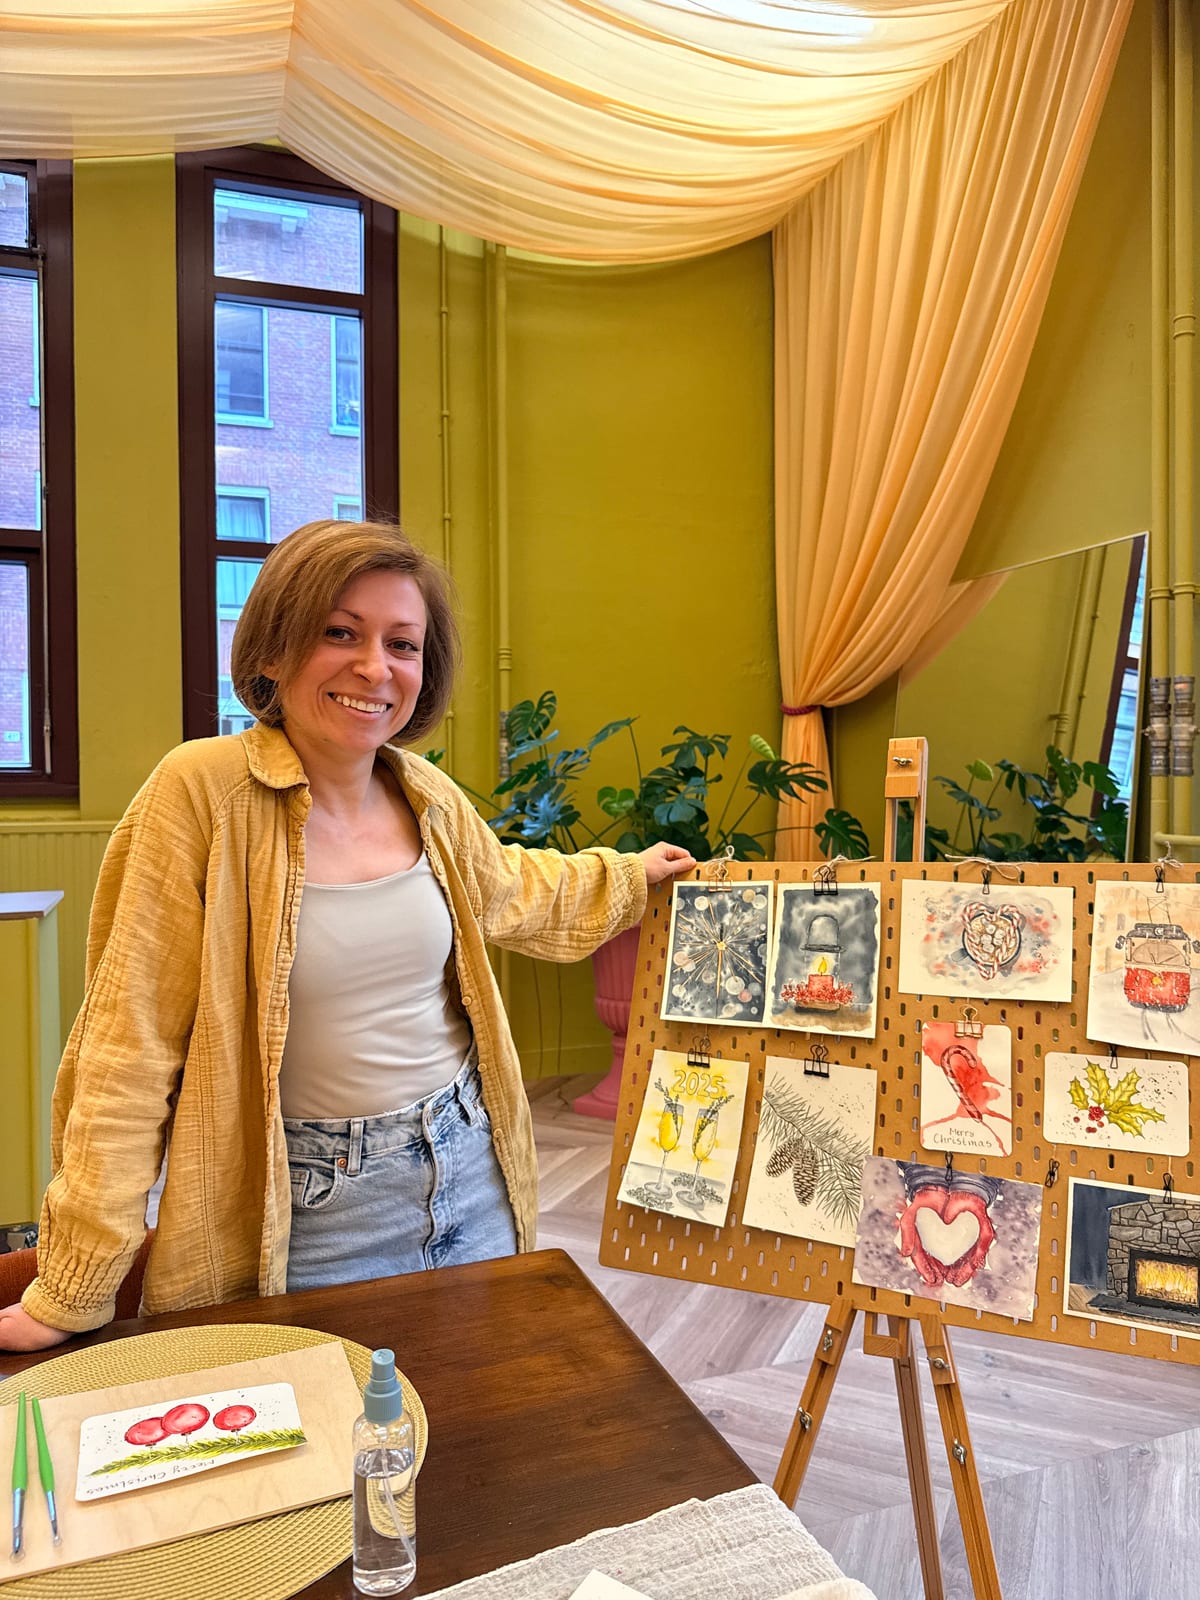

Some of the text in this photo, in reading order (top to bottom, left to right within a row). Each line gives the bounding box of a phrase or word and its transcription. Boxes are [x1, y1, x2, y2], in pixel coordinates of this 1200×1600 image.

[672, 1069, 725, 1100] 2025
[933, 1133, 992, 1148] Christmas
[949, 1127, 975, 1137] Merry
[86, 1459, 215, 1495] Merry Christmas
